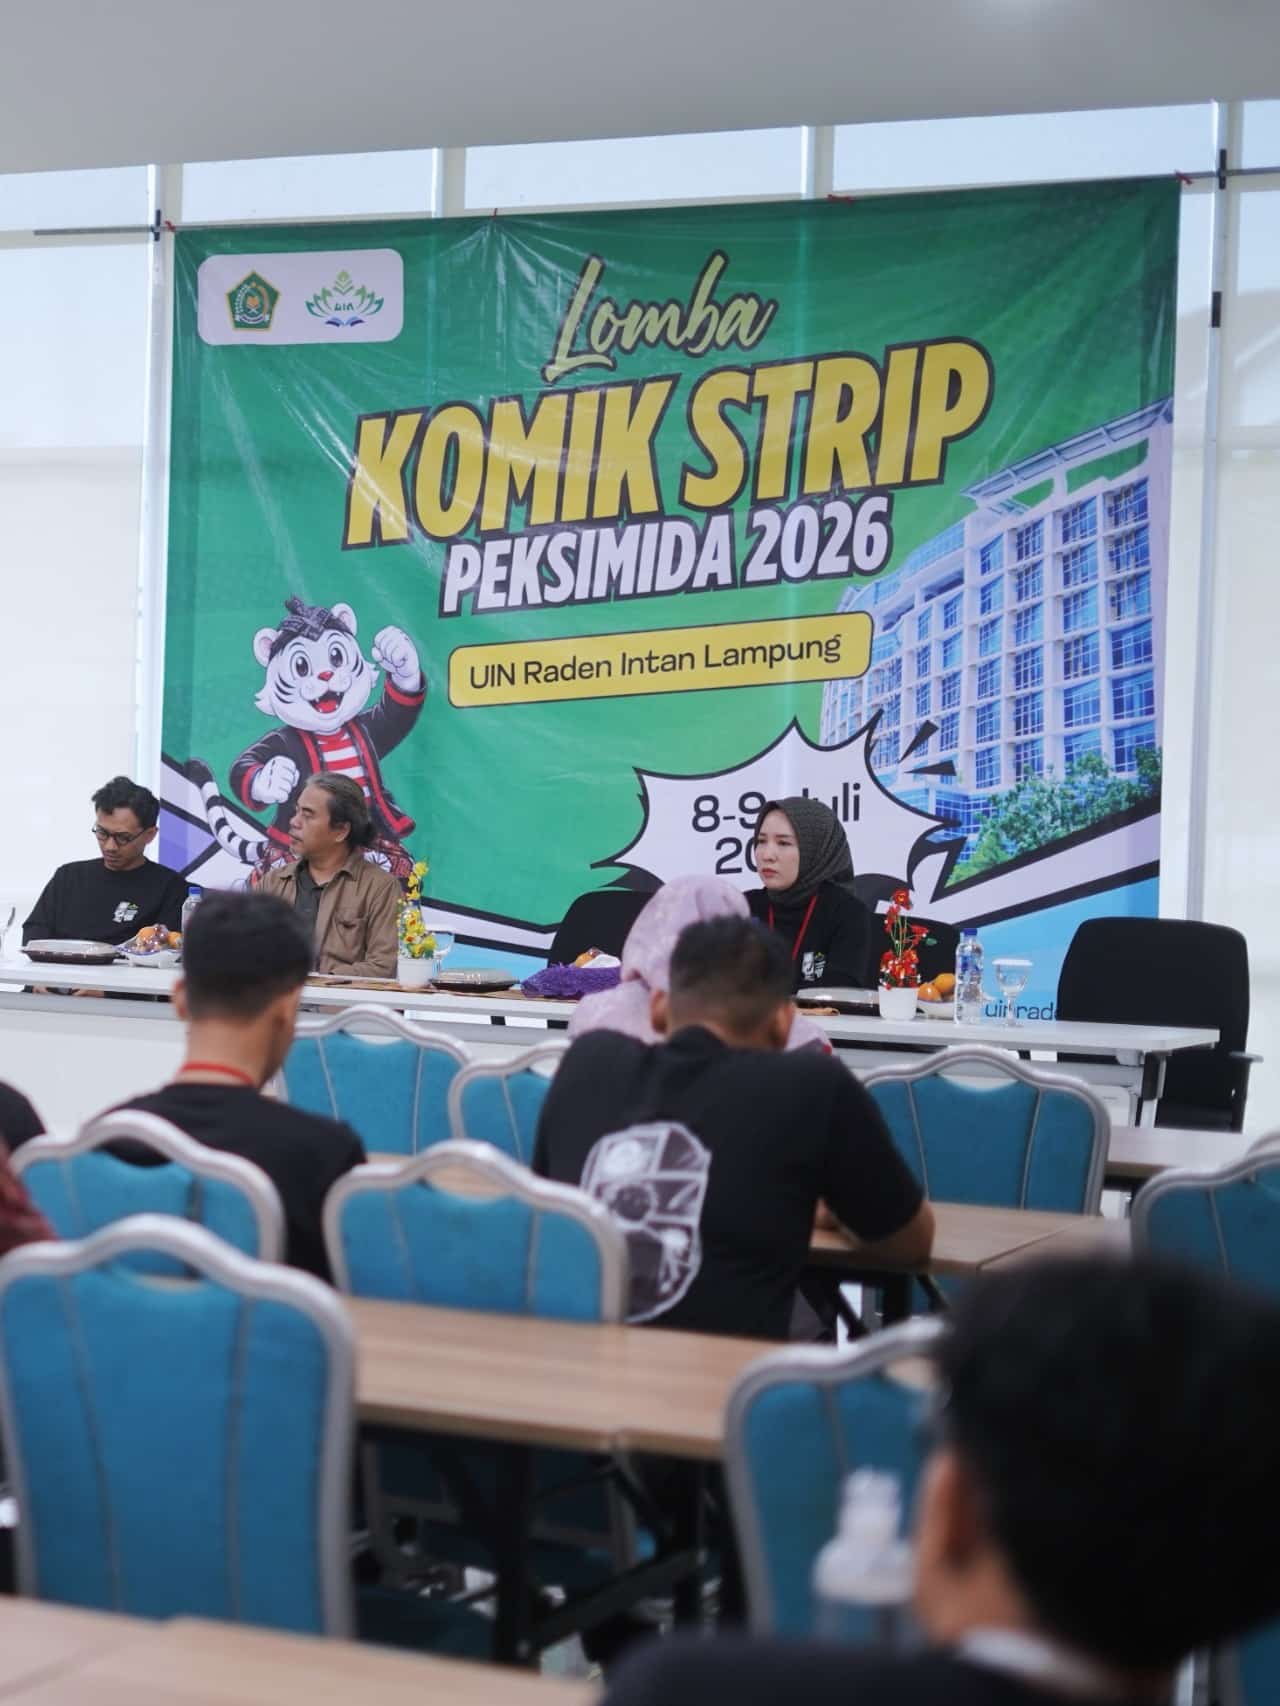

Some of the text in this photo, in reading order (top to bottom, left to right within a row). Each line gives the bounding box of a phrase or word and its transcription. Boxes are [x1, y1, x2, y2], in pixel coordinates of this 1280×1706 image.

[543, 252, 775, 382] Lomba
[344, 338, 993, 548] KOMIK STRIP
[441, 495, 890, 615] PEKSIMIDA 2026
[470, 634, 842, 689] UIN Raden Intan Lampung
[802, 782, 861, 822] li
